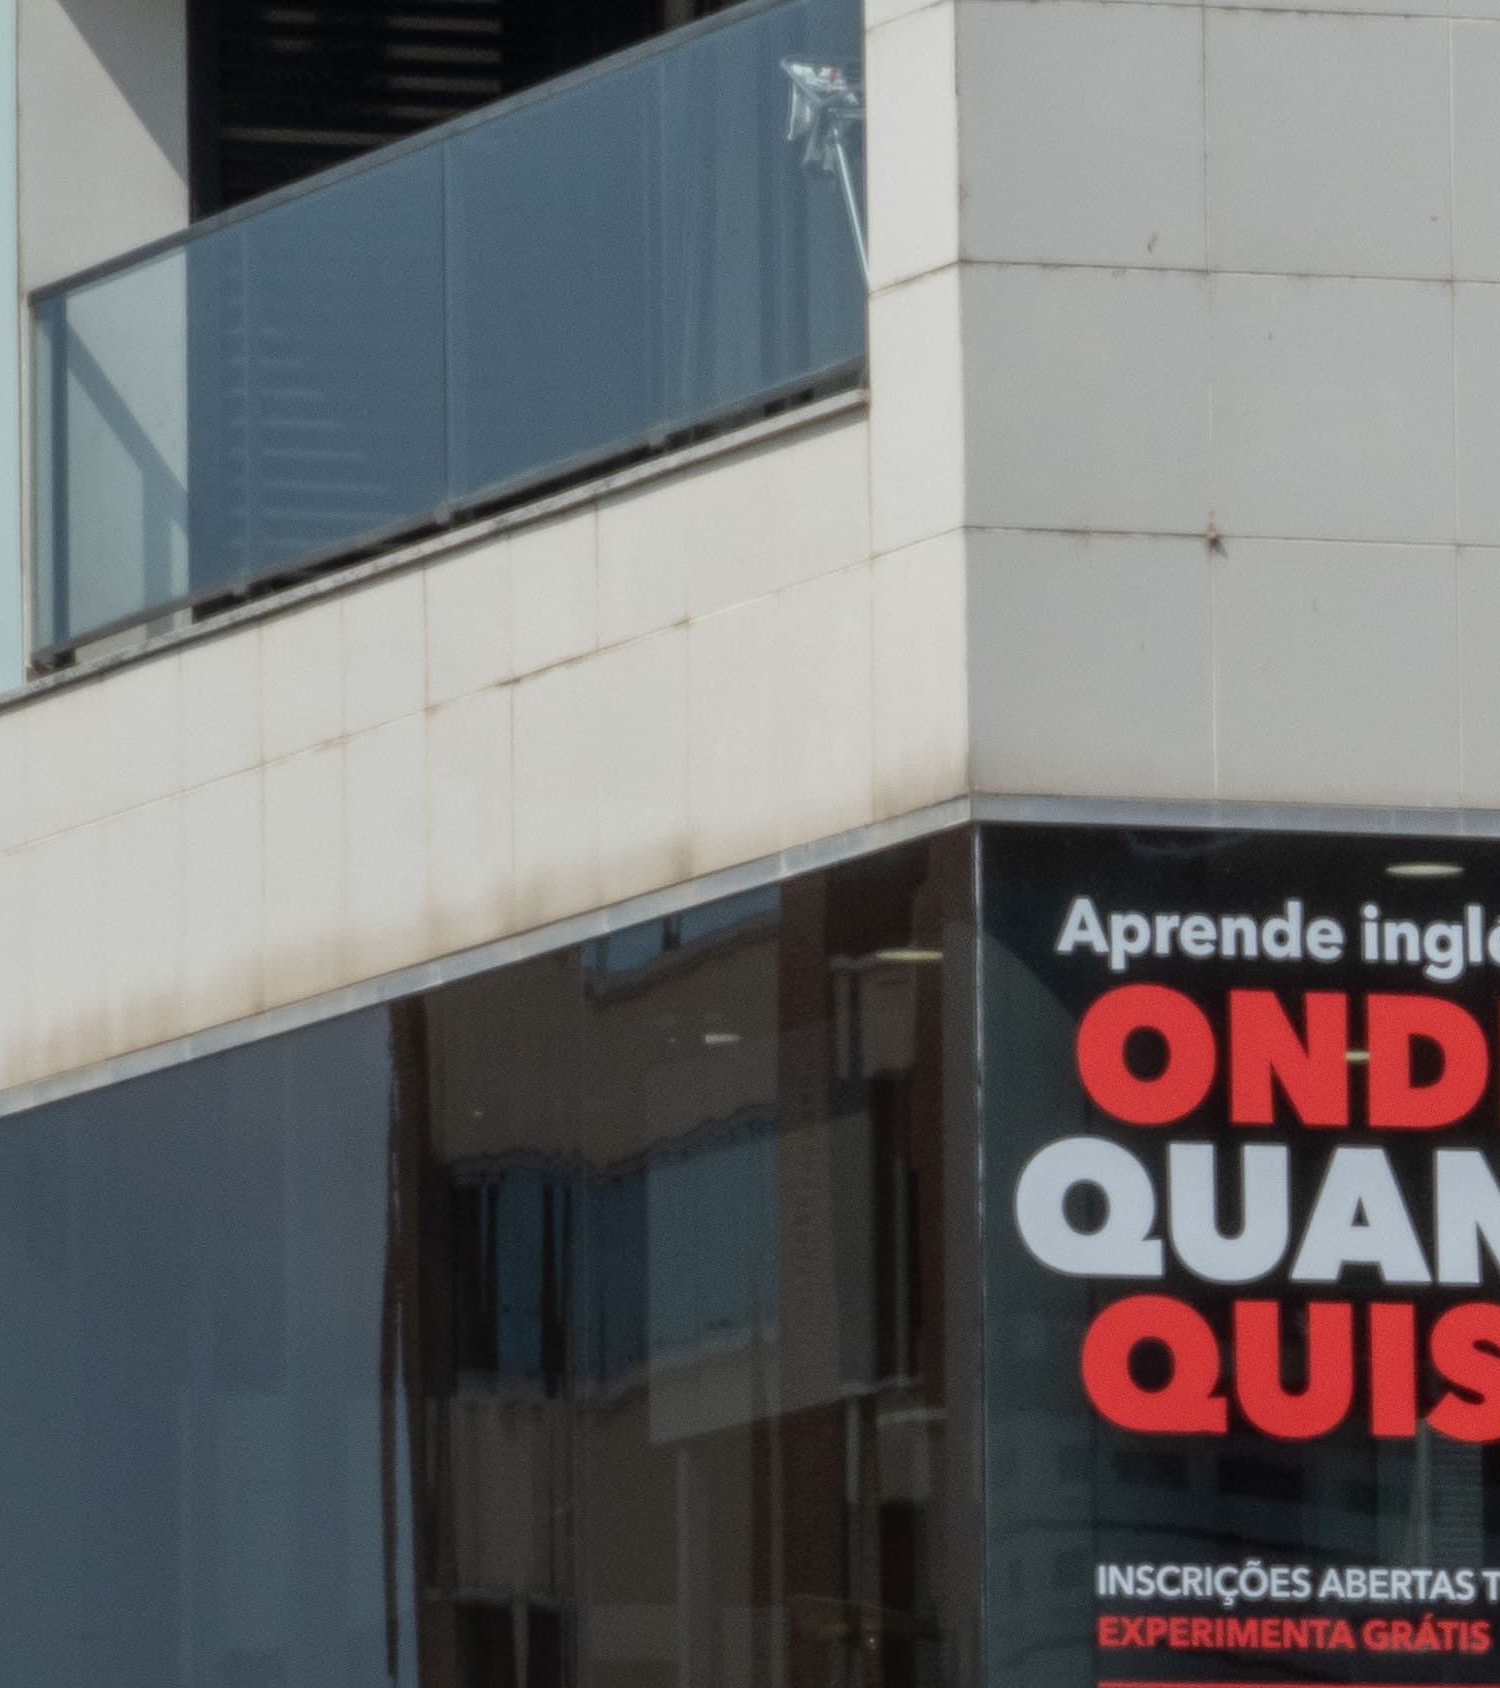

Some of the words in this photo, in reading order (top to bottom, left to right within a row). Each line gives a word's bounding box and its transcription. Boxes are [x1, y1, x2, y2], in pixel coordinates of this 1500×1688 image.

[1057, 897, 1345, 971] Aprende
[1098, 1559, 1311, 1606] INSCRIÇÕES
[1319, 1567, 1475, 1601] ABERTAS
[1098, 1615, 1356, 1650] EXPERIMENTA
[1362, 1612, 1492, 1653] GRÁTIS
